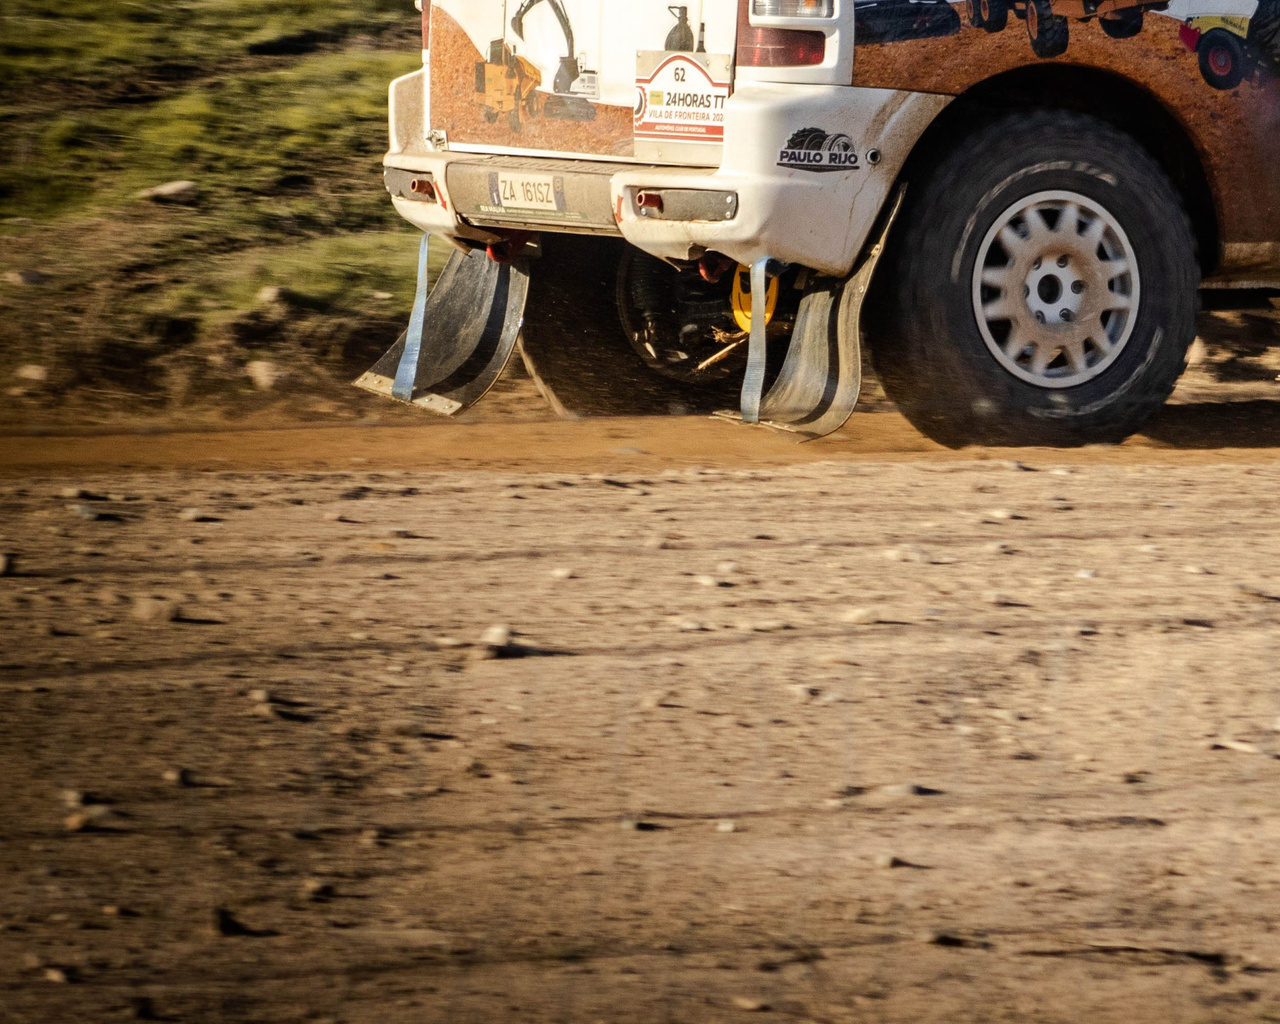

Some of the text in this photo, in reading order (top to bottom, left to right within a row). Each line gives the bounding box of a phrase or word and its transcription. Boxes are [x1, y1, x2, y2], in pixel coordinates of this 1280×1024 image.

[674, 67, 686, 82] 62
[713, 95, 726, 109] TT
[649, 110, 663, 119] VILA
[665, 111, 673, 119] DE
[674, 111, 710, 121] FRONTEIRA
[780, 151, 858, 165] PAULO RIJO
[501, 180, 517, 201] ZA
[521, 183, 553, 203] 161SZ
